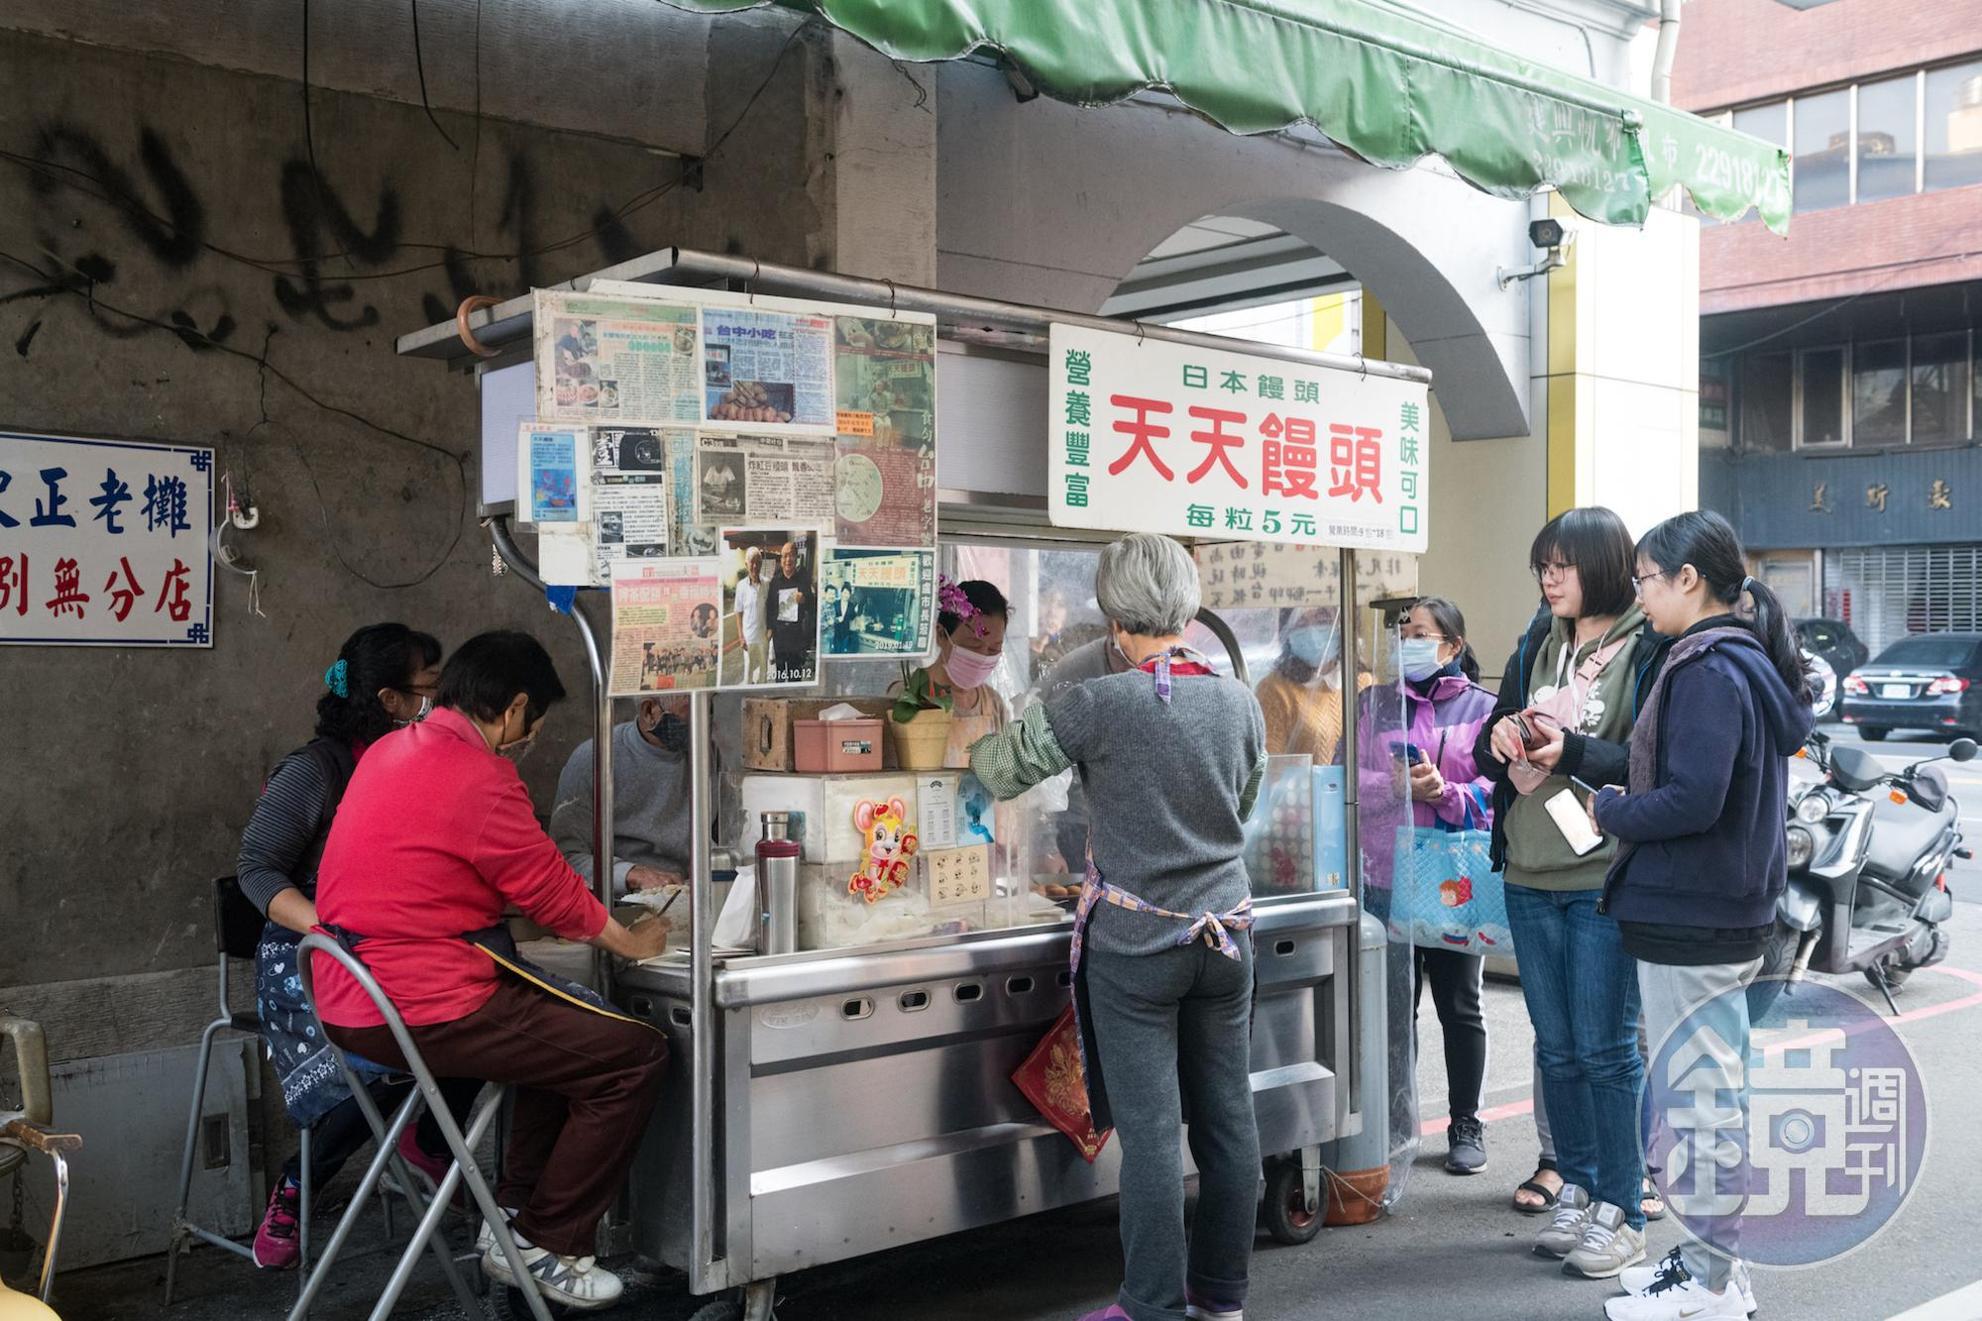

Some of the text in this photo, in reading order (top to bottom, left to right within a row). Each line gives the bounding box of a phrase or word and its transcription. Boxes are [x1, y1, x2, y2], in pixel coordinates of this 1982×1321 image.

[716, 324, 777, 340] 台中小吃
[1182, 363, 1320, 405] 日本饅頭
[1064, 348, 1092, 508] 營養豐富
[1107, 393, 1384, 504] 天天饅頭
[1399, 401, 1420, 535] 美味可口
[1186, 503, 1317, 536] 每粒5元
[767, 668, 812, 680] 2016.10.12
